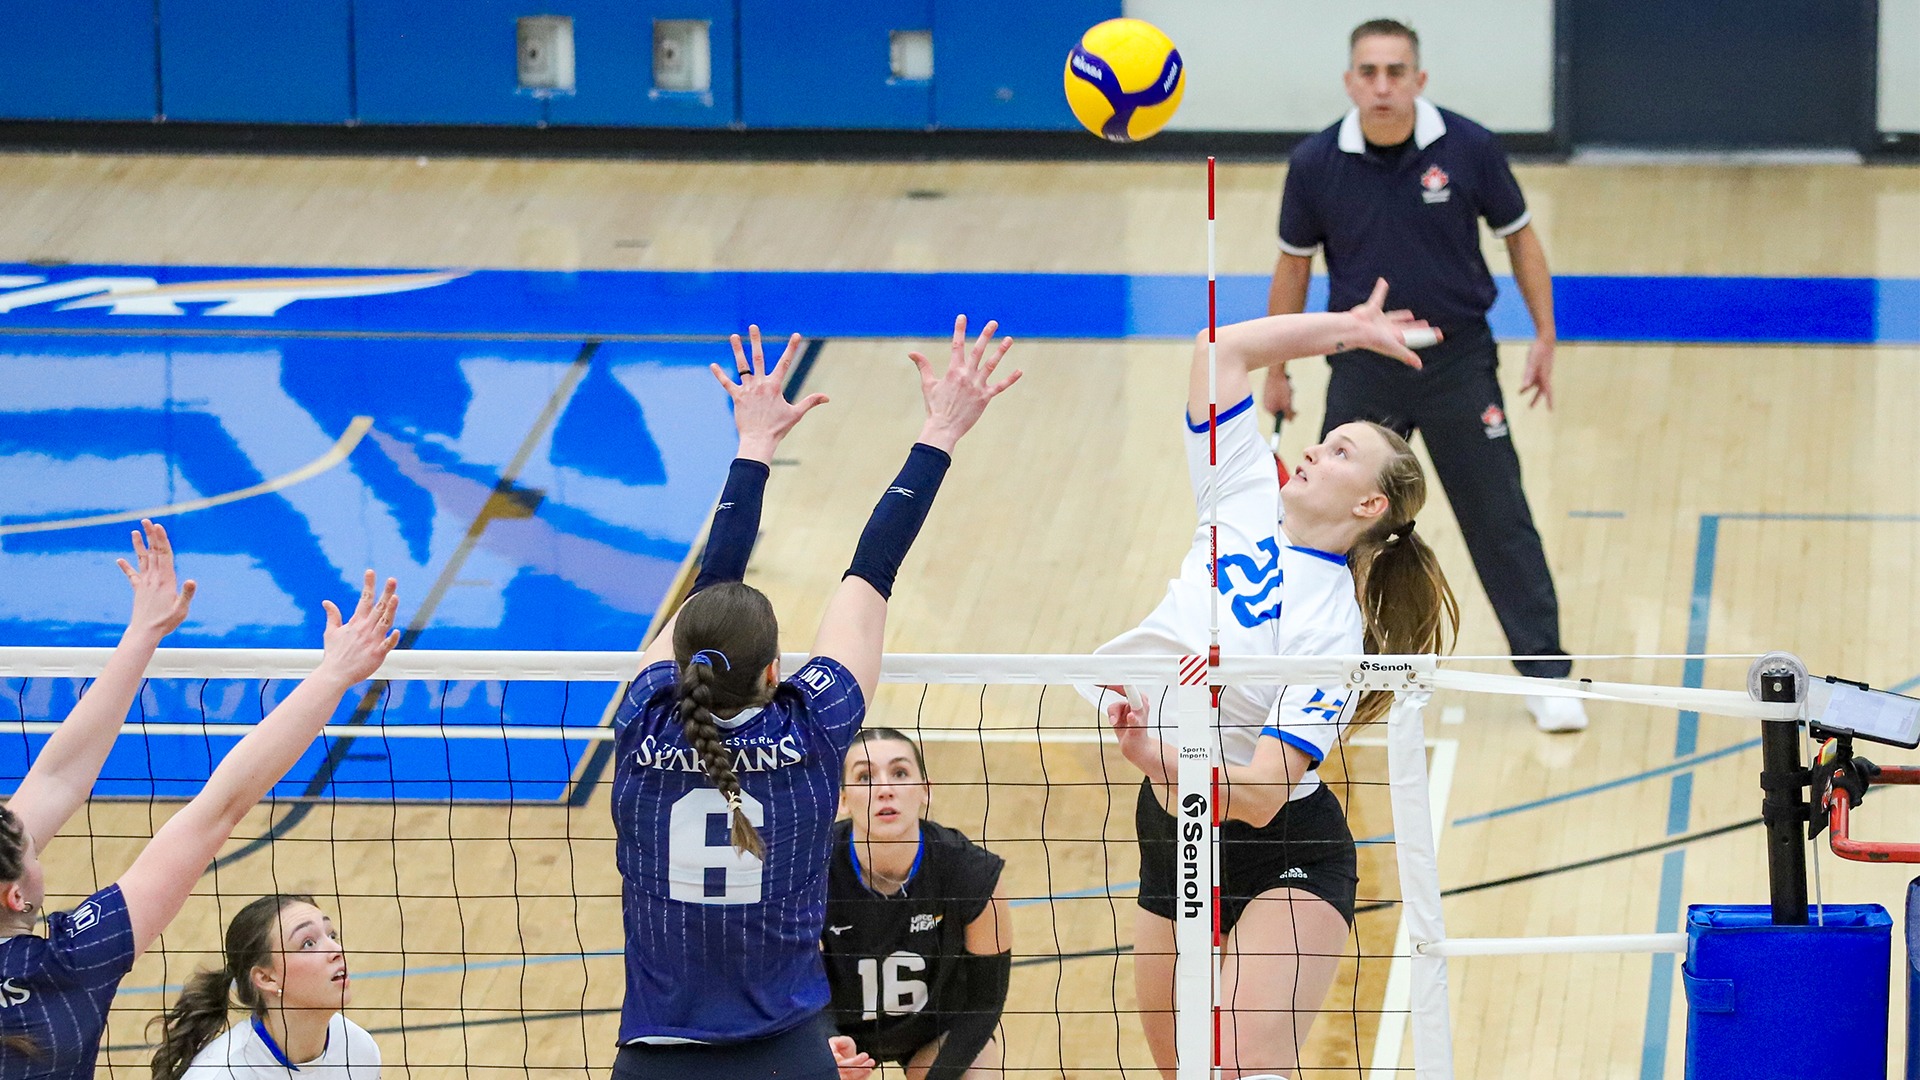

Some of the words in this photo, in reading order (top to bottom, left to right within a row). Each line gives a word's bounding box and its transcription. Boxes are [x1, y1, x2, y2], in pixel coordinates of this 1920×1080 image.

[1371, 662, 1412, 671] Senoh
[668, 787, 764, 905] 6
[1182, 822, 1204, 919] Senoh
[858, 951, 928, 1020] 16
